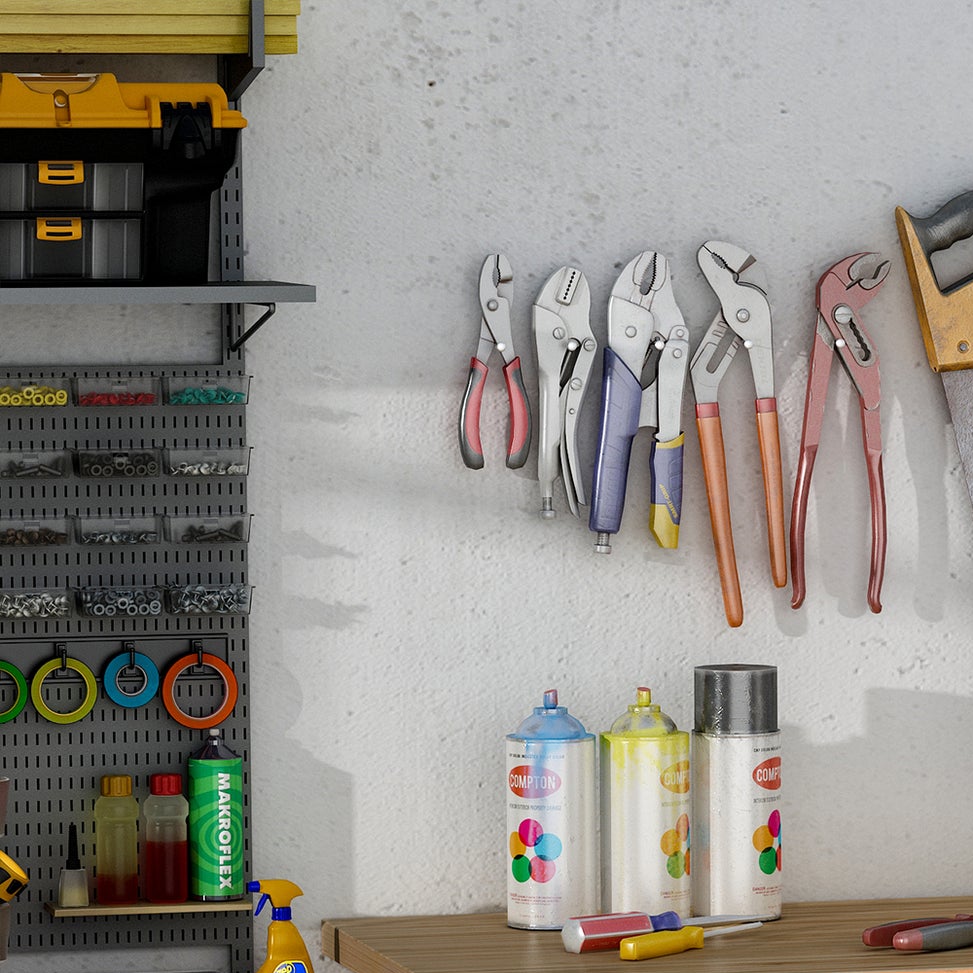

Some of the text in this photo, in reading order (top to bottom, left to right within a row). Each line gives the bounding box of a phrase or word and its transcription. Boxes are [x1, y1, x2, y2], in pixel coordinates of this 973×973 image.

[510, 774, 556, 790] COMPTON
[663, 770, 690, 786] COMP
[218, 772, 233, 890] MAKROFLEX
